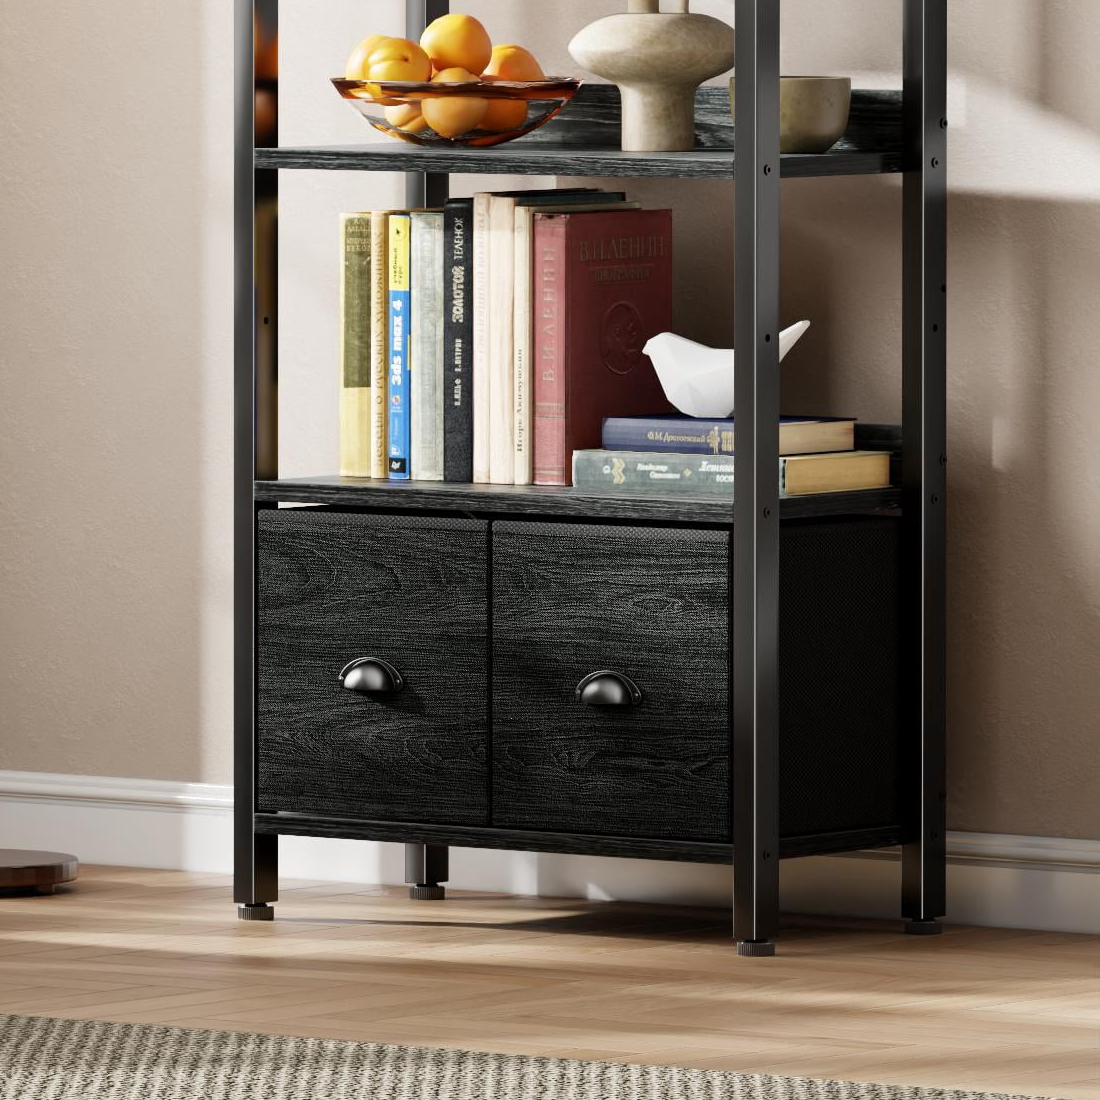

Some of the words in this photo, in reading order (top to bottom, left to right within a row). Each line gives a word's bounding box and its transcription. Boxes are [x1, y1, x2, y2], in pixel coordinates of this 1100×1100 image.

[392, 299, 404, 312] 4
[393, 315, 403, 351] max
[391, 355, 402, 386] 3ds
